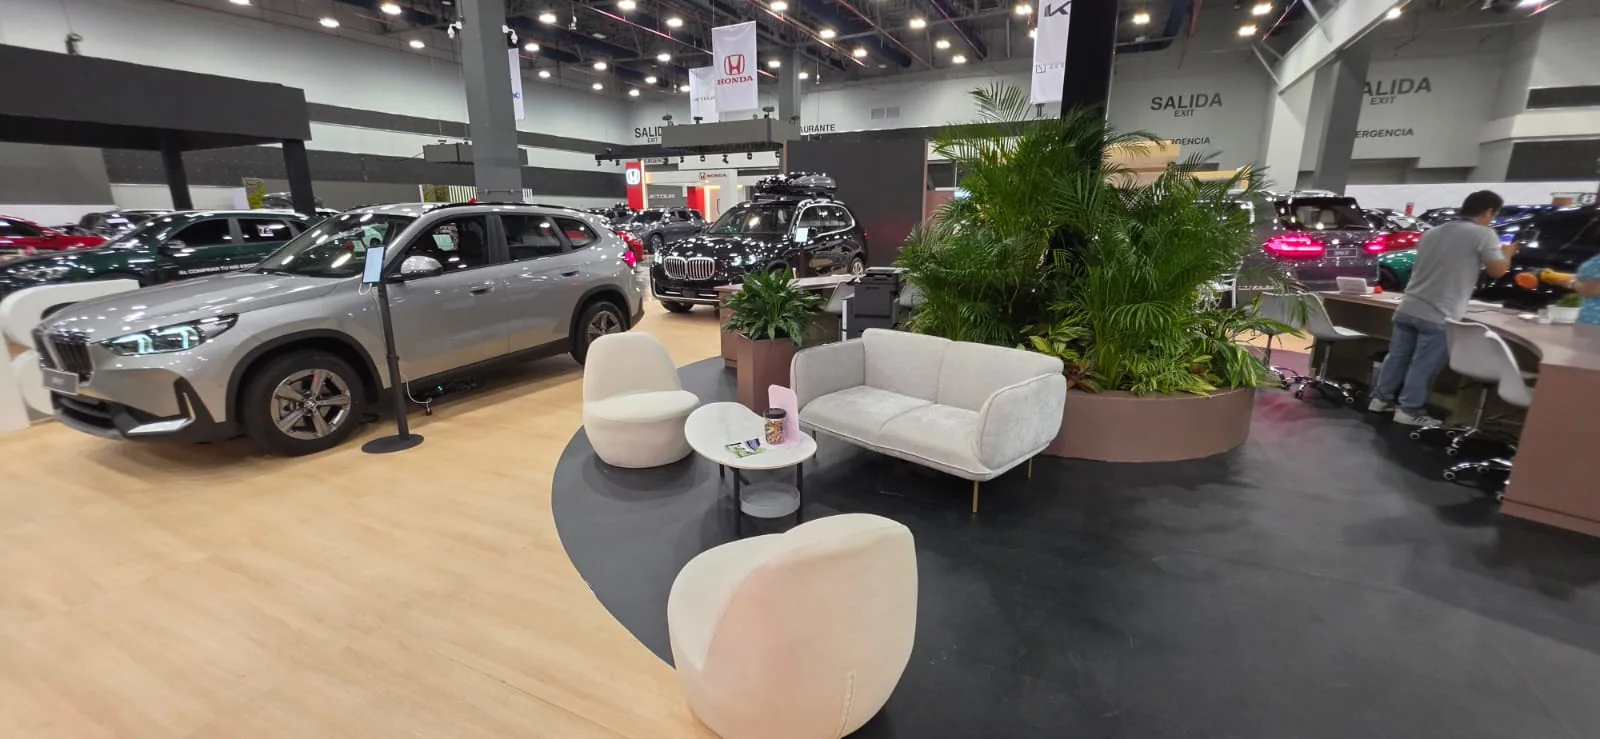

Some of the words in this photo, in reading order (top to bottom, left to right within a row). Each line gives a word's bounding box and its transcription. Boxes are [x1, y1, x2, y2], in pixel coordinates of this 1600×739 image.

[717, 75, 753, 85] HONDA
[1362, 76, 1432, 96] ALIDA
[1150, 92, 1223, 111] SALIDA
[1370, 95, 1398, 105] EXIT
[1174, 109, 1195, 117] EXIT
[800, 123, 836, 133] AURANTE
[1355, 128, 1414, 138] ERGENCIA
